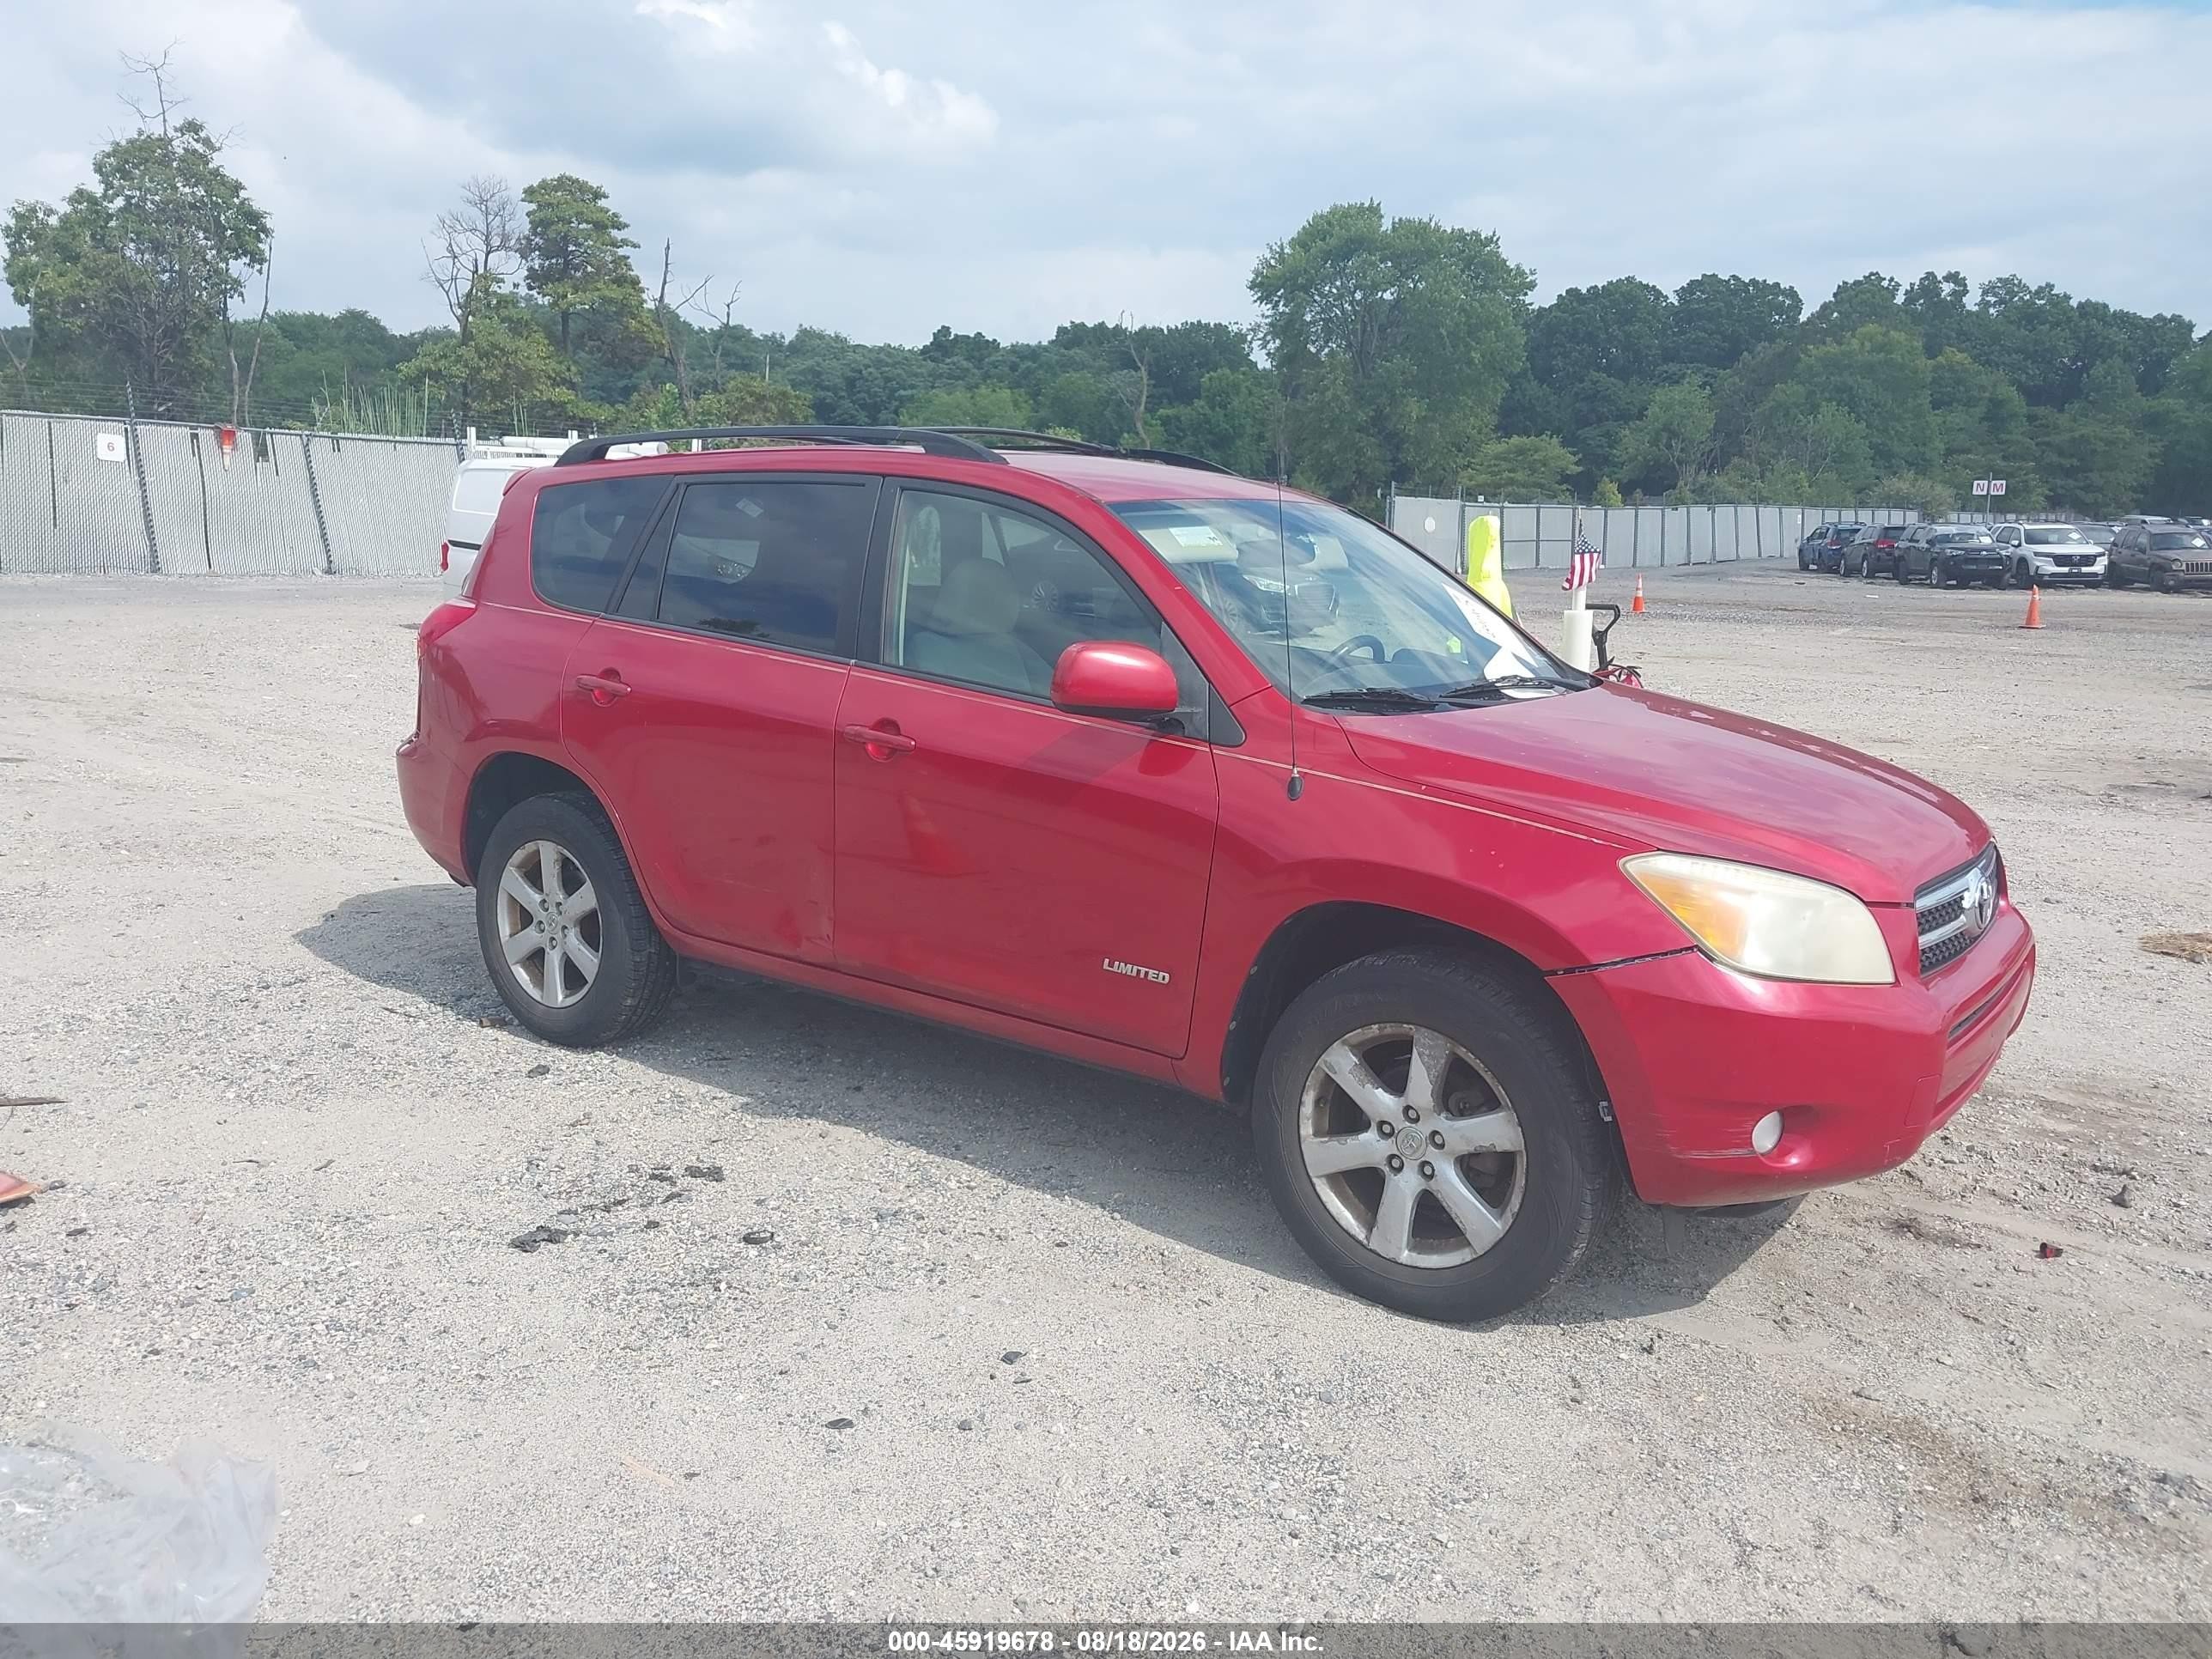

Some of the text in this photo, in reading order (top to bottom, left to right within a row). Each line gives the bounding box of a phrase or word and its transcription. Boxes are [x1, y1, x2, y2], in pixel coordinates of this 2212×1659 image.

[106, 441, 115, 452] 6
[1976, 483, 2003, 492] N M
[1103, 957, 1170, 984] LIMITED
